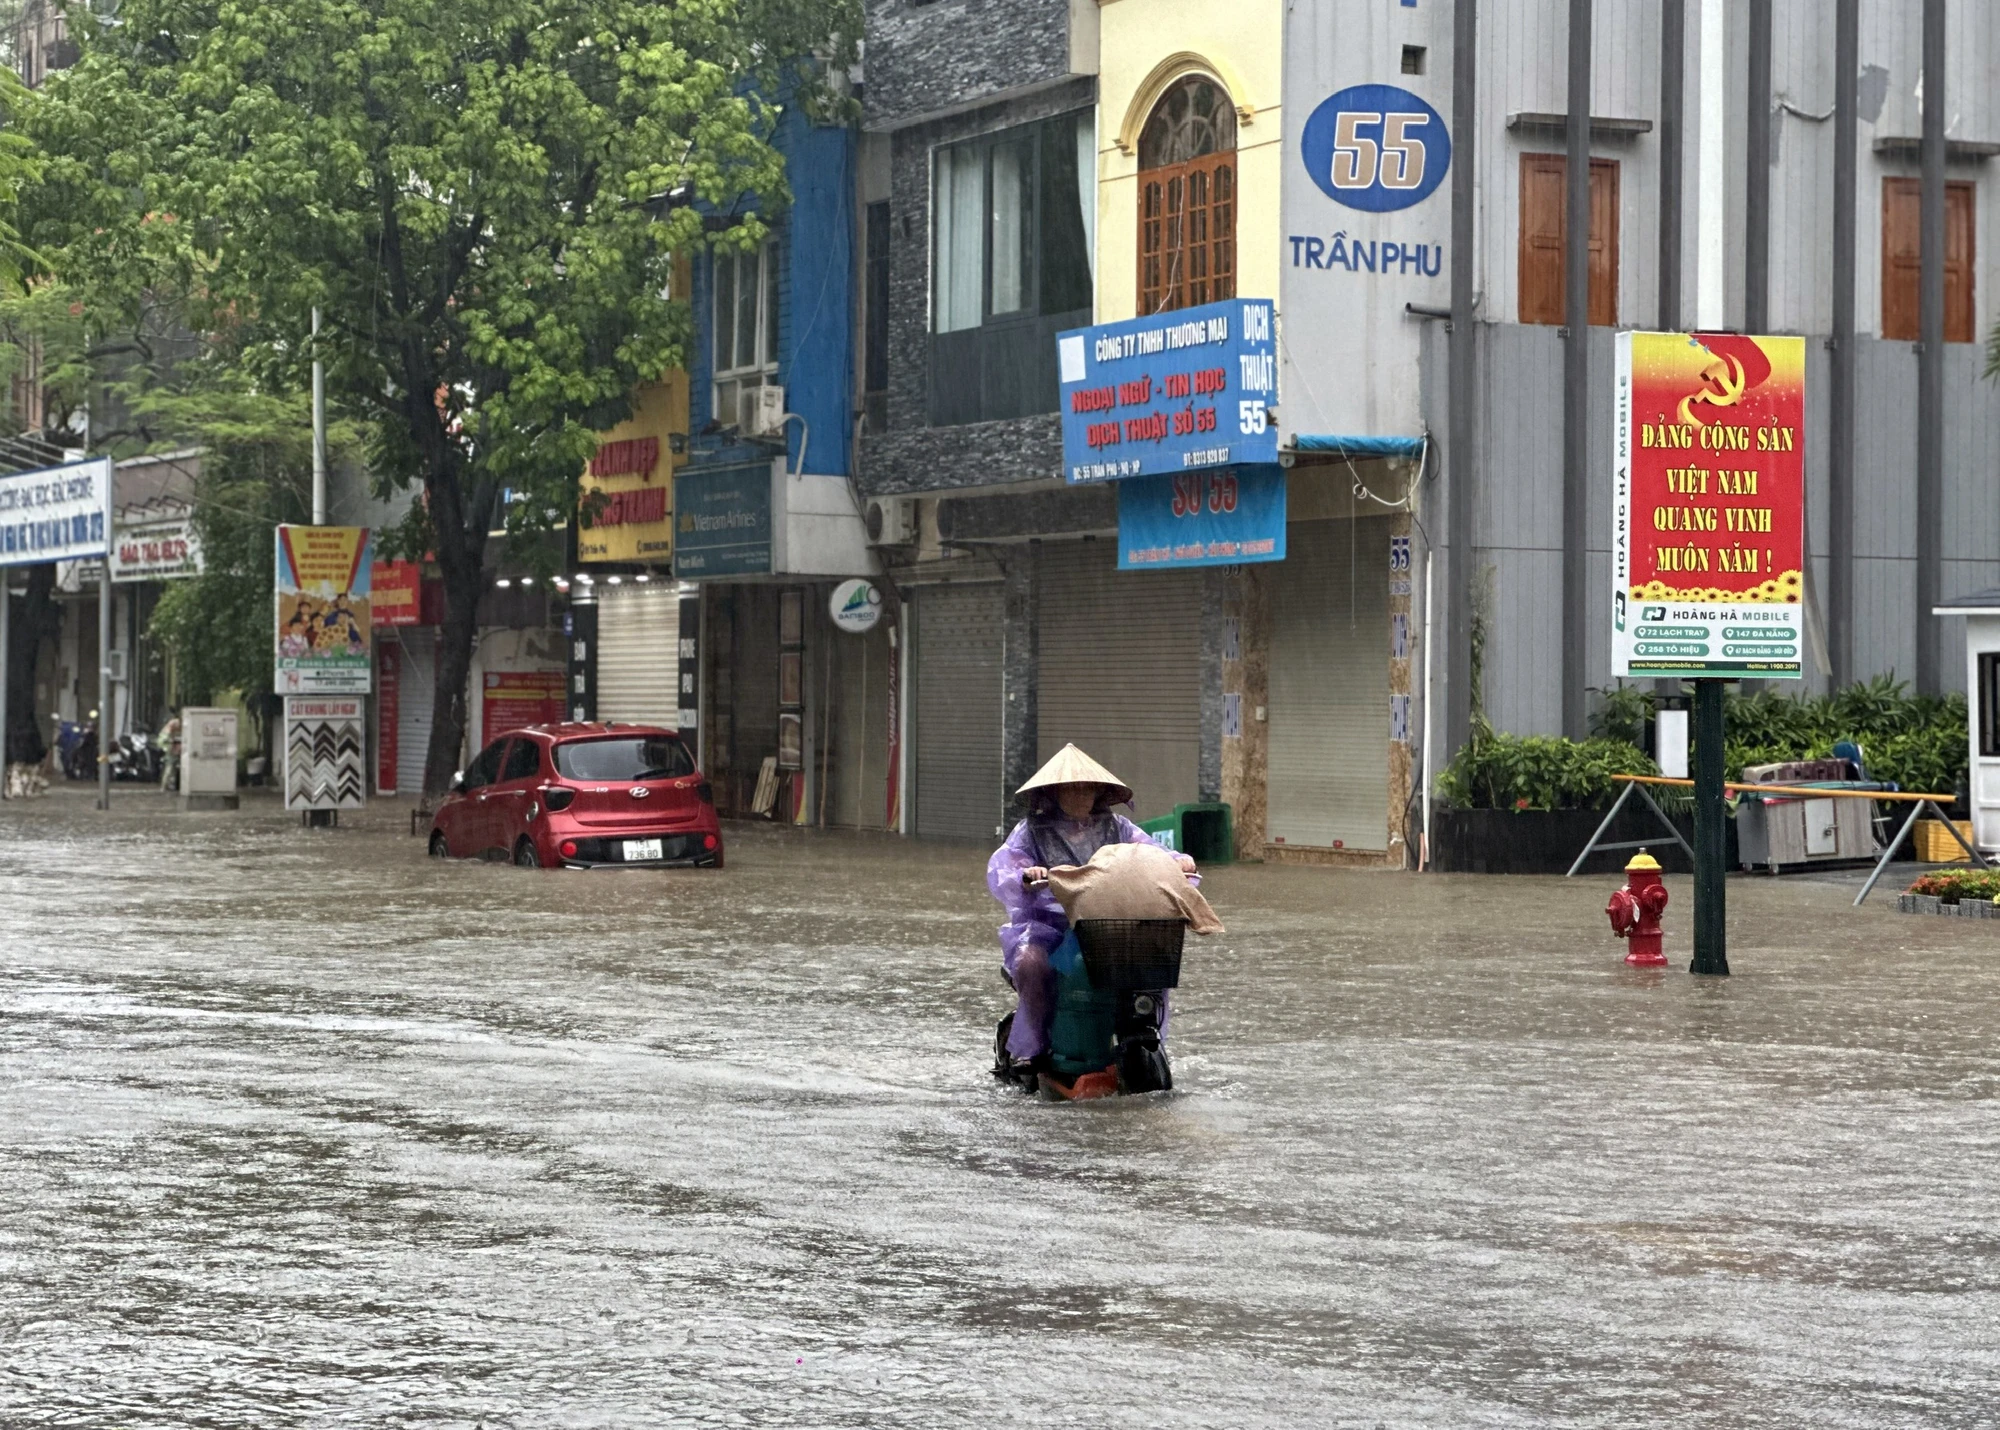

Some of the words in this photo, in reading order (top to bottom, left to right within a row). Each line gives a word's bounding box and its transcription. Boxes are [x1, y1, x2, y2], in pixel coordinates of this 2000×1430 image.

[1330, 112, 1430, 189] 55
[1289, 229, 1376, 273] TRẦN
[1096, 334, 1122, 362] CÔNG
[1124, 335, 1136, 358] TY
[1138, 329, 1164, 355] TNHH
[1166, 322, 1206, 349] THƯƠNG
[1208, 316, 1228, 346] MẠI
[1243, 304, 1268, 346] DỊCH
[1240, 349, 1272, 396] THUẬT
[1071, 386, 1115, 414] NGOẠI
[1118, 374, 1152, 406] NGỮ
[1164, 373, 1190, 398] TIN
[1194, 367, 1226, 398] HỌC
[1086, 422, 1121, 449] DỊCH
[1124, 410, 1169, 443] THUẬT
[1172, 400, 1194, 435] SỐ
[1196, 406, 1217, 432] 55
[1239, 400, 1267, 434] 55
[1641, 413, 1693, 448] ĐẢNG
[1700, 420, 1749, 457] CỘNG
[1757, 416, 1794, 452] SẢN
[1082, 466, 1090, 479] 55
[1618, 466, 1626, 496] HÀ
[1666, 462, 1710, 500] VIỆT
[1717, 470, 1758, 494] NAM
[1208, 470, 1238, 514] 55
[1654, 506, 1717, 532] QUANG
[1725, 508, 1772, 532] VINH
[1390, 536, 1410, 571] 55
[1617, 504, 1626, 578] HOÀNG
[1656, 541, 1710, 572] MUÔN
[1718, 542, 1758, 572] NĂM
[1766, 550, 1772, 572] !
[1673, 608, 1716, 620] HOÀNG
[1720, 609, 1738, 620] HÀ
[1742, 612, 1790, 621] MOBILE
[1659, 630, 1683, 638] LẠCH
[1666, 644, 1678, 653] TÔ
[1680, 645, 1700, 654] HIỆU
[1752, 628, 1764, 637] ĐÀ
[1631, 662, 1706, 670] www.hoanghamobile.com
[1747, 662, 1769, 670] Hotline:
